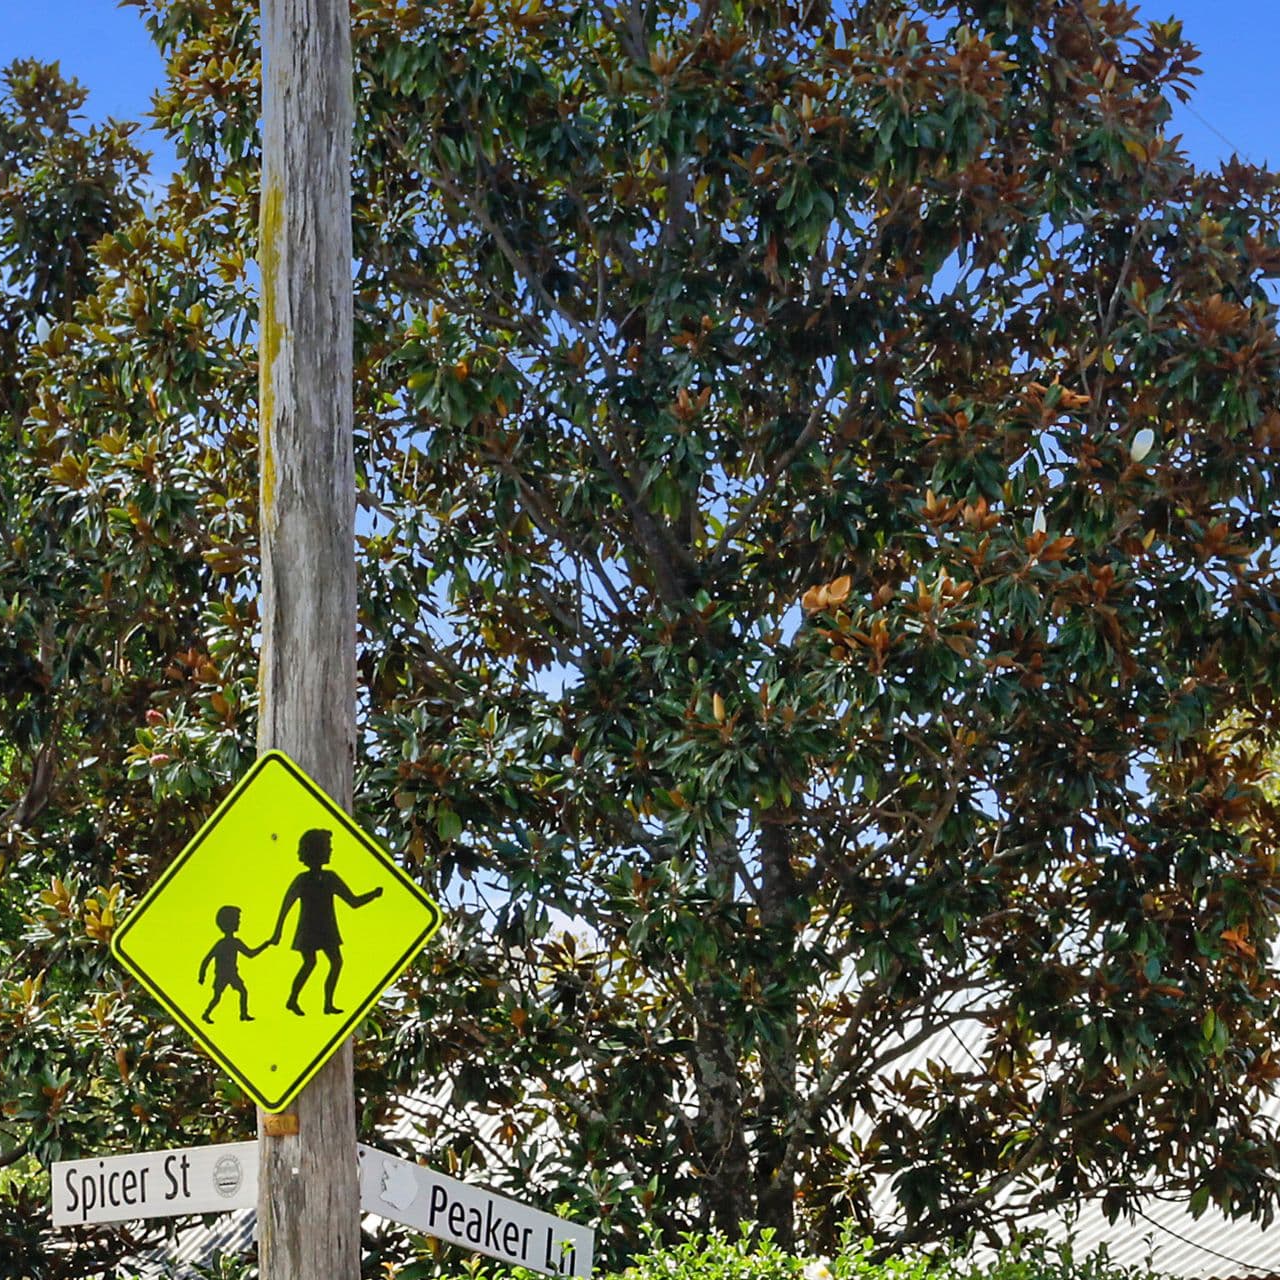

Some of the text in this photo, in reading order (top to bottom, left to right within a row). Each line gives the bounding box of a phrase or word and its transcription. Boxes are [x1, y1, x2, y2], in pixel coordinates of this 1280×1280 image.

[65, 1161, 149, 1221] Spicer
[164, 1154, 191, 1200] St
[428, 1185, 576, 1277] Peaker Ln
